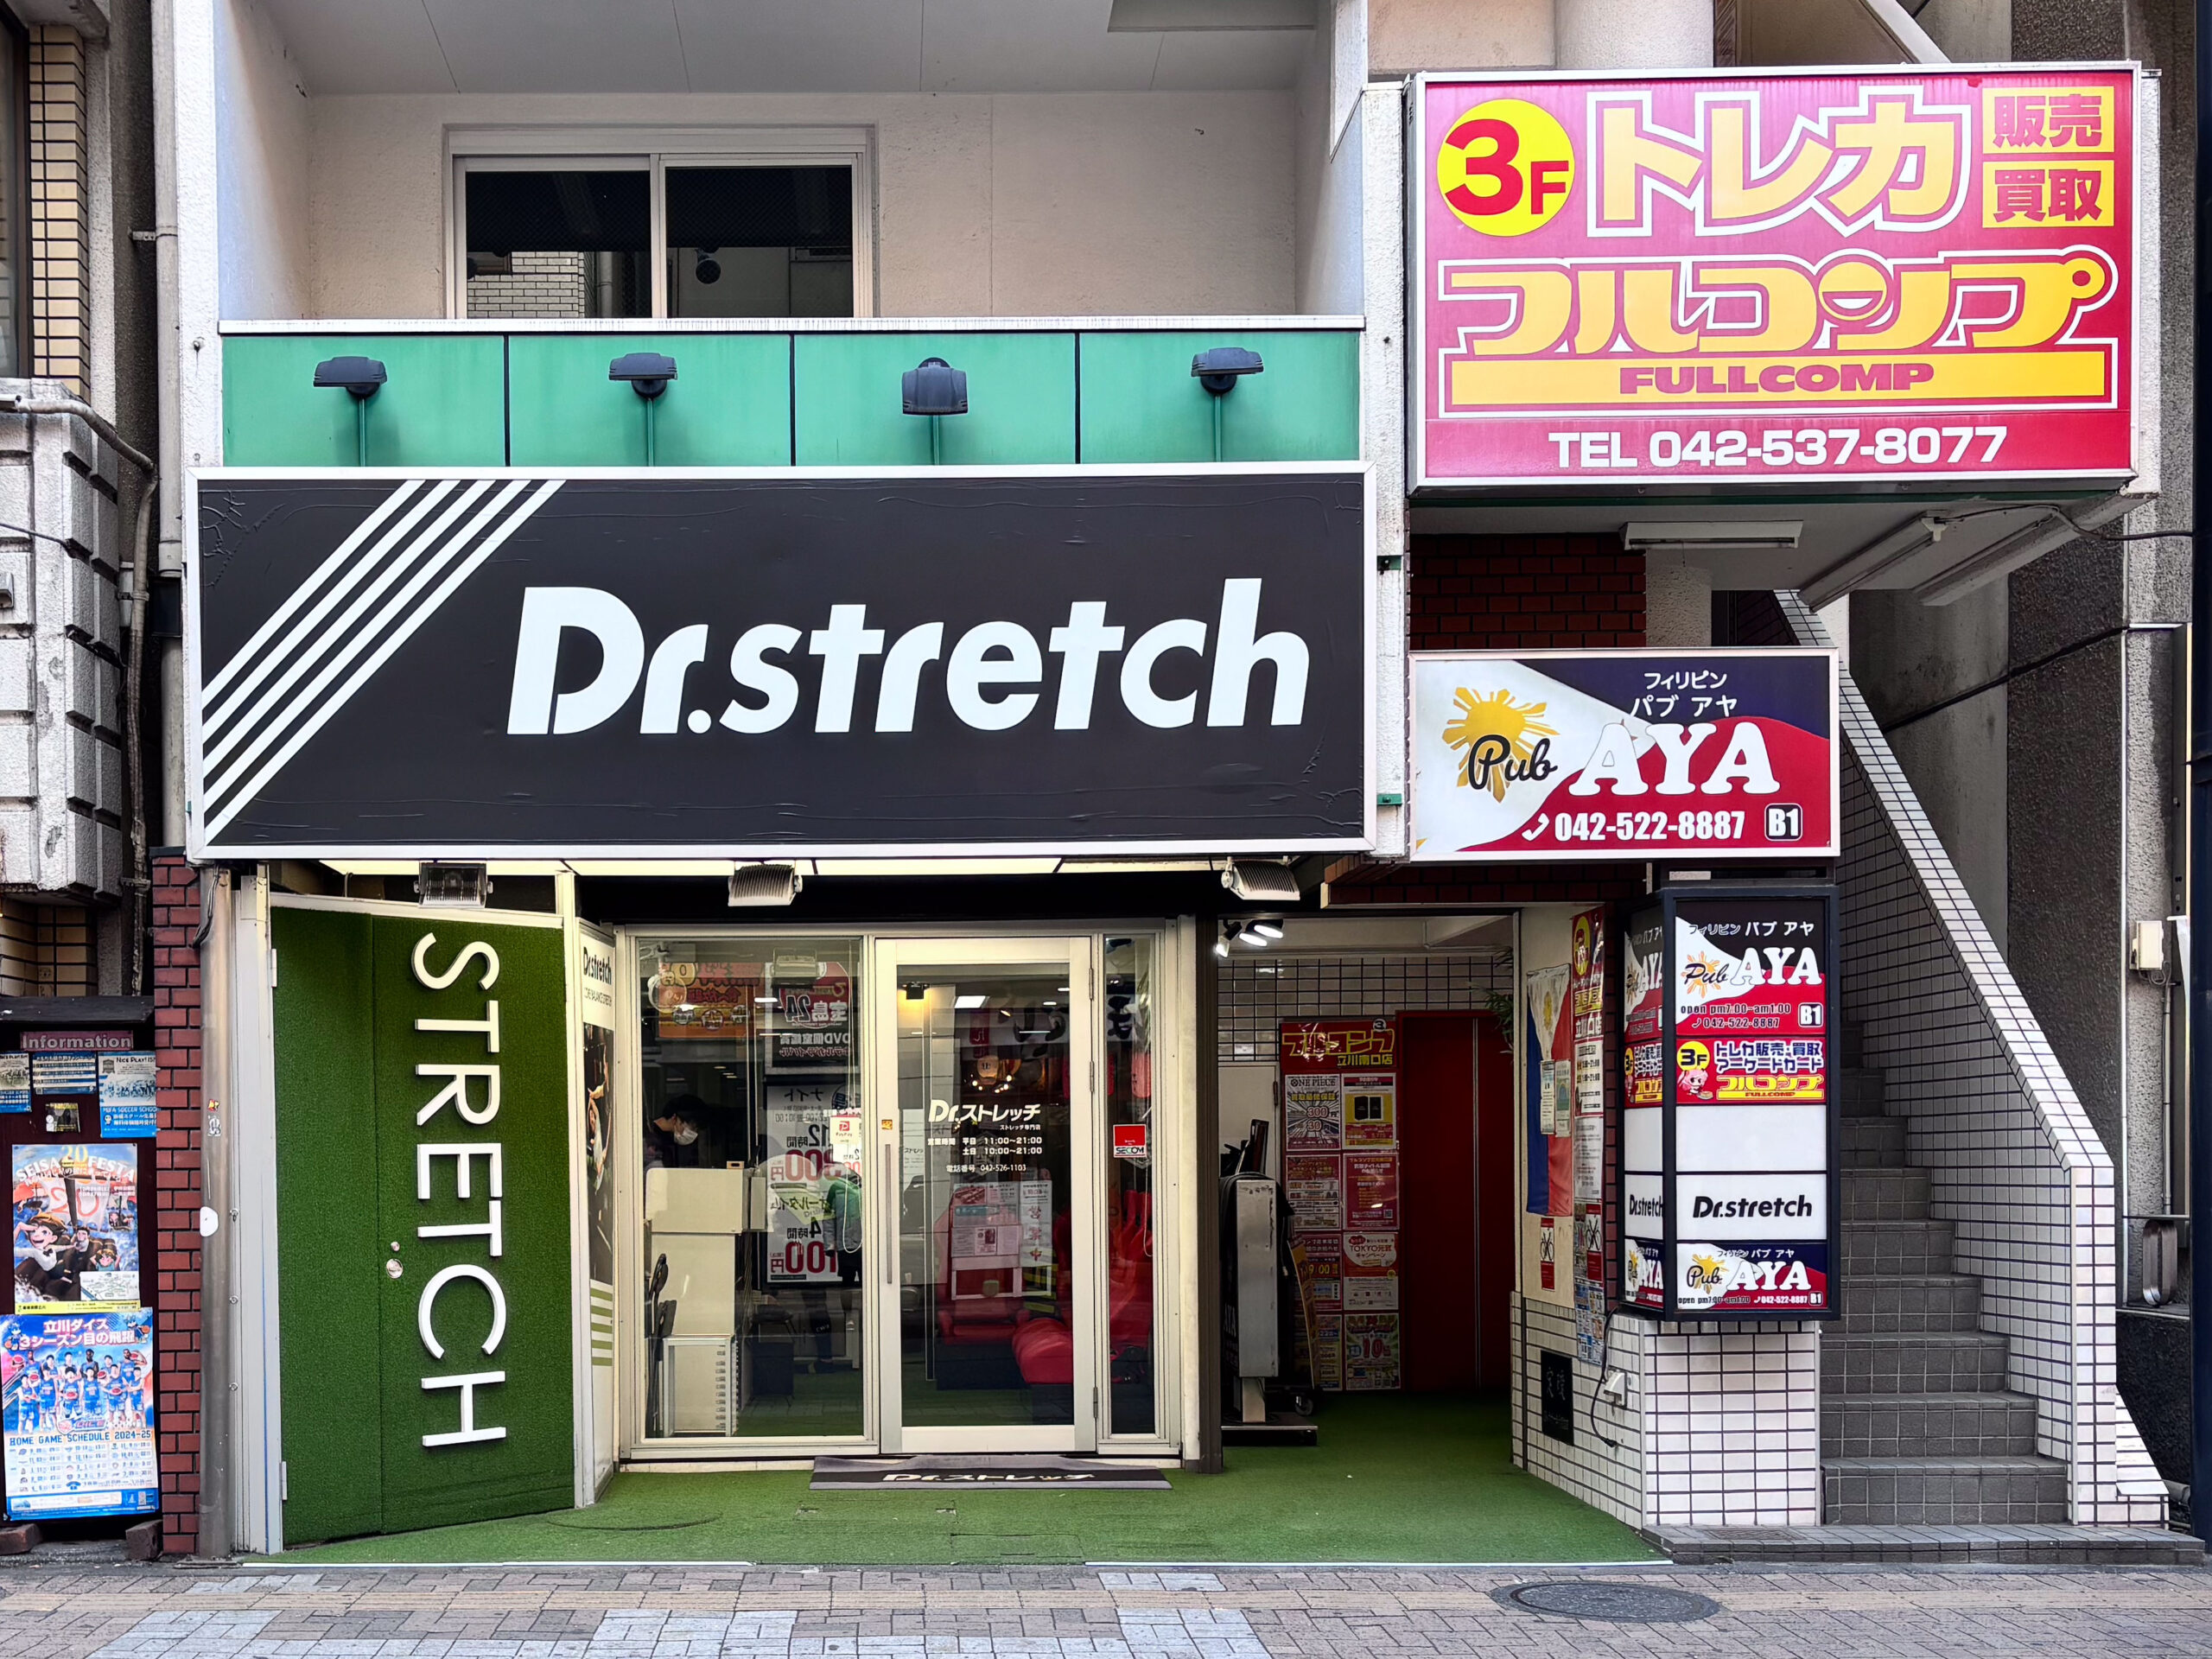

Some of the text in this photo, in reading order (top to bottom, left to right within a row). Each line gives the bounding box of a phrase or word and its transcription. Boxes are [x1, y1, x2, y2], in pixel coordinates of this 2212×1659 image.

[1993, 95, 2103, 149] 販売
[1446, 118, 1569, 216] 3F
[1590, 87, 1971, 236] トレカ
[1993, 168, 2102, 222] 買取
[1441, 247, 2117, 354] フルコンプ
[1619, 362, 1934, 394] FULLCOMP
[1549, 425, 2008, 469] TEL 042-537-8077
[507, 577, 1311, 734] Dr.stretch
[1643, 671, 1728, 691] フィリピン
[1630, 695, 1738, 718] パブ アヤ
[1468, 721, 1781, 798] Pub AYA
[1554, 810, 1745, 842] 042-522-8887
[1767, 809, 1801, 837] B1
[1688, 921, 1815, 938] フィリピン パブ アヤ
[1684, 947, 1822, 986] Pub AYA
[1681, 1005, 1707, 1015] open
[1800, 1005, 1822, 1026] B1
[1703, 1018, 1780, 1028] 042-522-8887
[22, 1035, 131, 1049] Information
[1681, 1048, 1707, 1065] 3F
[1291, 1078, 1336, 1087] ONE PIECE
[1716, 1075, 1824, 1091] フルコンプ
[928, 1099, 1040, 1122] Dr.ストレッチ
[1306, 1106, 1329, 1118] 300
[1307, 1120, 1323, 1132] 30
[962, 1137, 976, 1146] 平日
[16, 1157, 61, 1182] SEISA
[88, 1156, 135, 1182] FESTA
[980, 1164, 1027, 1173] 042-526-1103
[410, 932, 508, 1447] STRETCH
[1693, 1194, 1812, 1218] Dr.stretch
[1687, 1261, 1812, 1291] Pub AYA
[43, 1318, 109, 1333] 立川ダイス
[10, 1430, 151, 1446] HOME GAME SCHEDULE 2024-25
